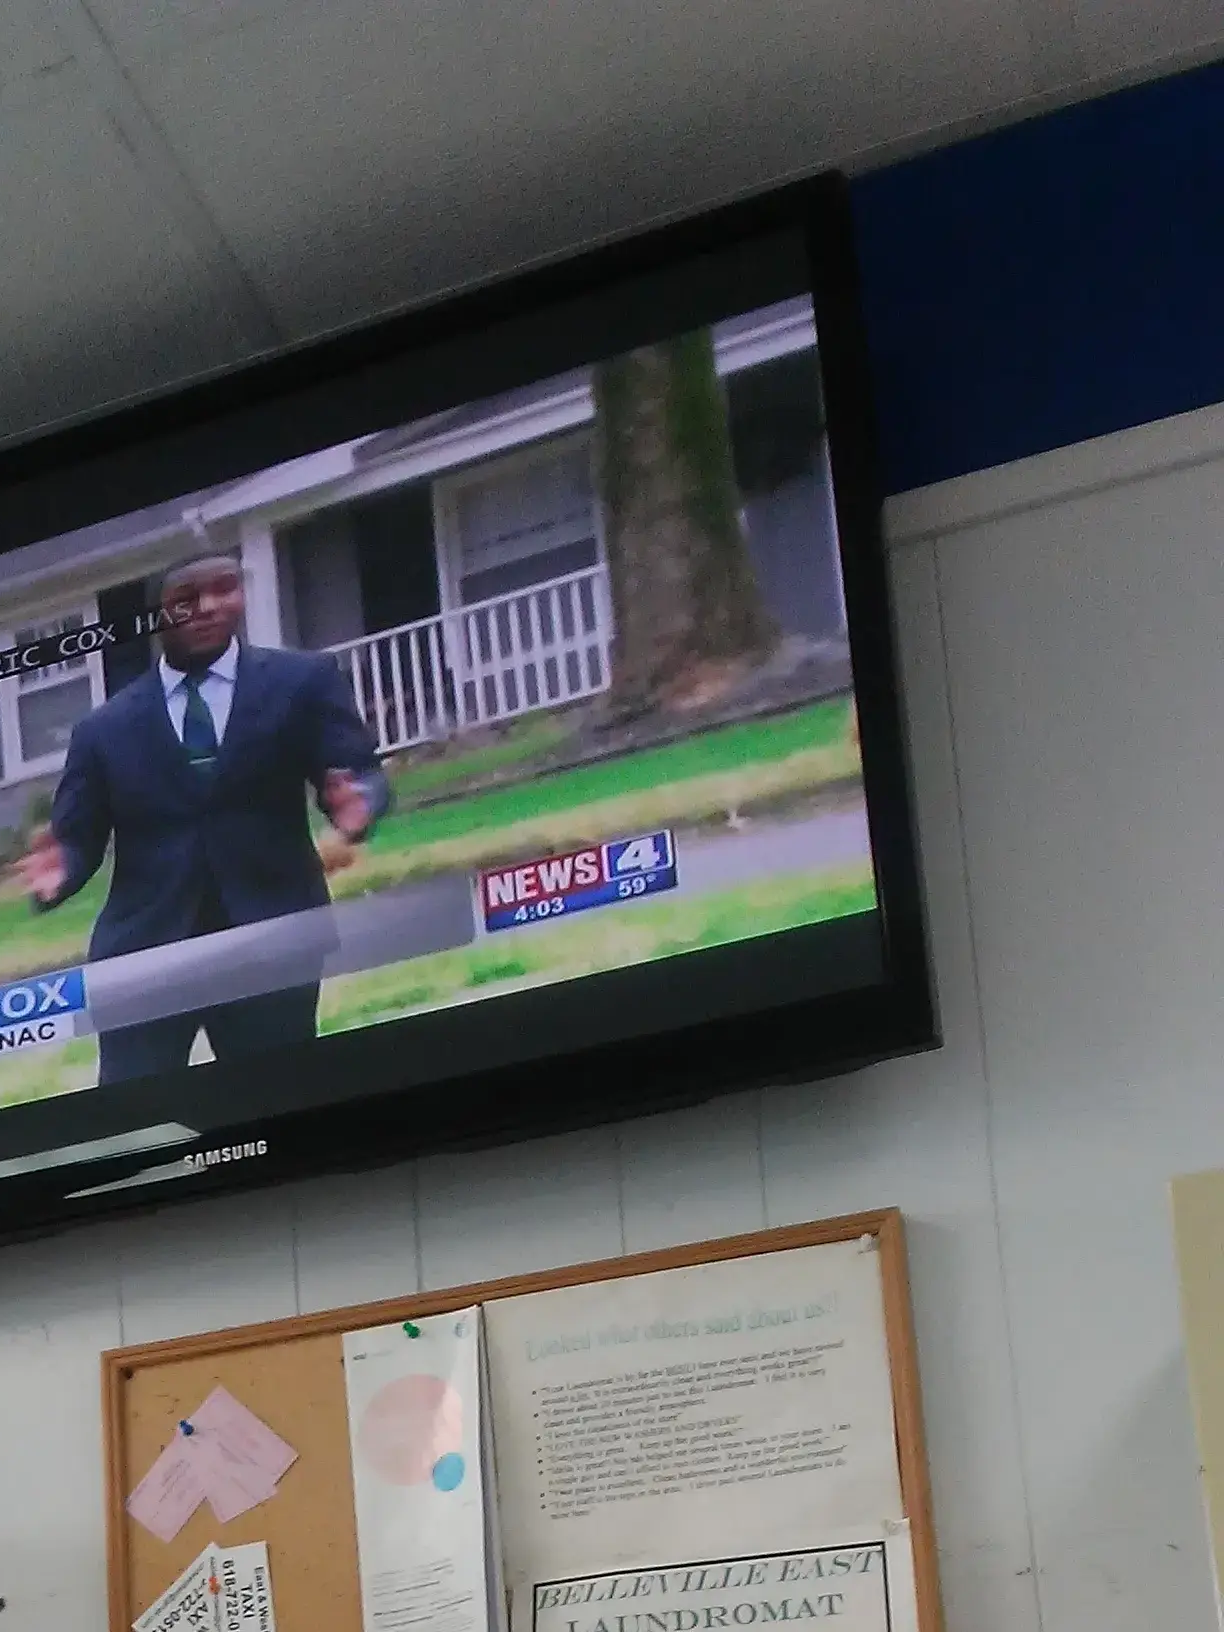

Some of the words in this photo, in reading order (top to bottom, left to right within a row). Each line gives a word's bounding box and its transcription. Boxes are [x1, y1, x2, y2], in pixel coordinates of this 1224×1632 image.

[59, 623, 117, 656] COX
[135, 600, 194, 635] HAS
[485, 850, 600, 908] NEWS
[616, 836, 662, 872] 4
[514, 896, 566, 922] 4:03
[184, 1140, 268, 1170] SAMSUNG
[536, 1561, 770, 1611] BELLEVILLE
[778, 1549, 883, 1583] EAST
[187, 1602, 209, 1626] AXI
[240, 1584, 255, 1619] TAXI
